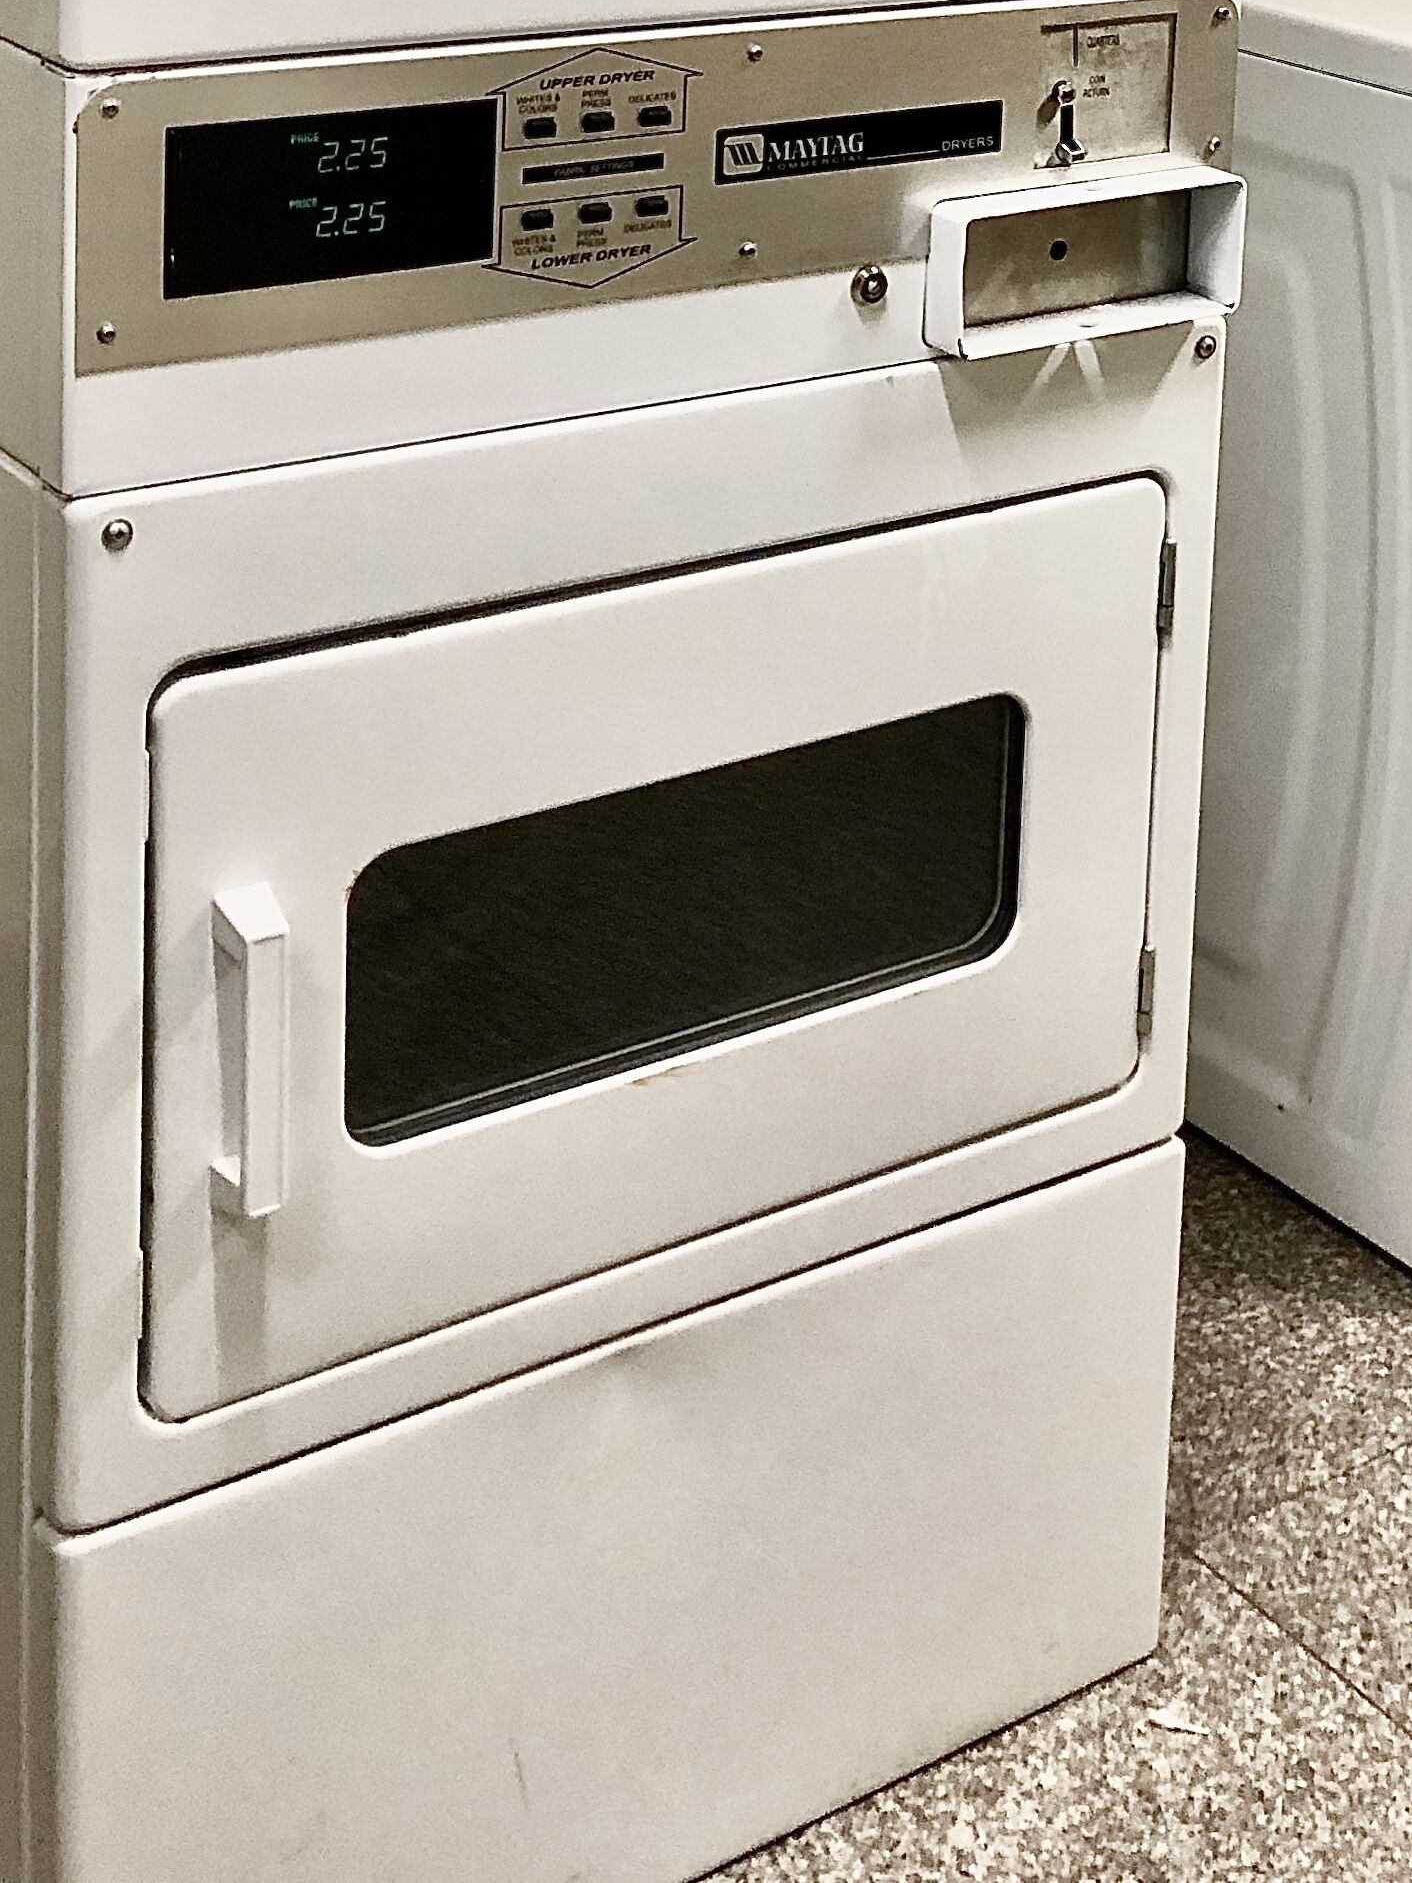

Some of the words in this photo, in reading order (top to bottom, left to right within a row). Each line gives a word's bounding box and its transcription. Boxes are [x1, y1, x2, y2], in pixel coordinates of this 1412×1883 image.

[539, 75, 596, 90] UPPER
[599, 70, 656, 85] DRYER
[628, 90, 677, 104] DELICATES
[318, 137, 388, 173] 2.25
[768, 131, 864, 163] MAYTAG
[942, 136, 994, 151] DRYERS
[767, 155, 865, 171] COMMERCIAL
[316, 201, 386, 237] 2.25
[531, 252, 593, 270] LOWER
[595, 244, 652, 262] DRYER
